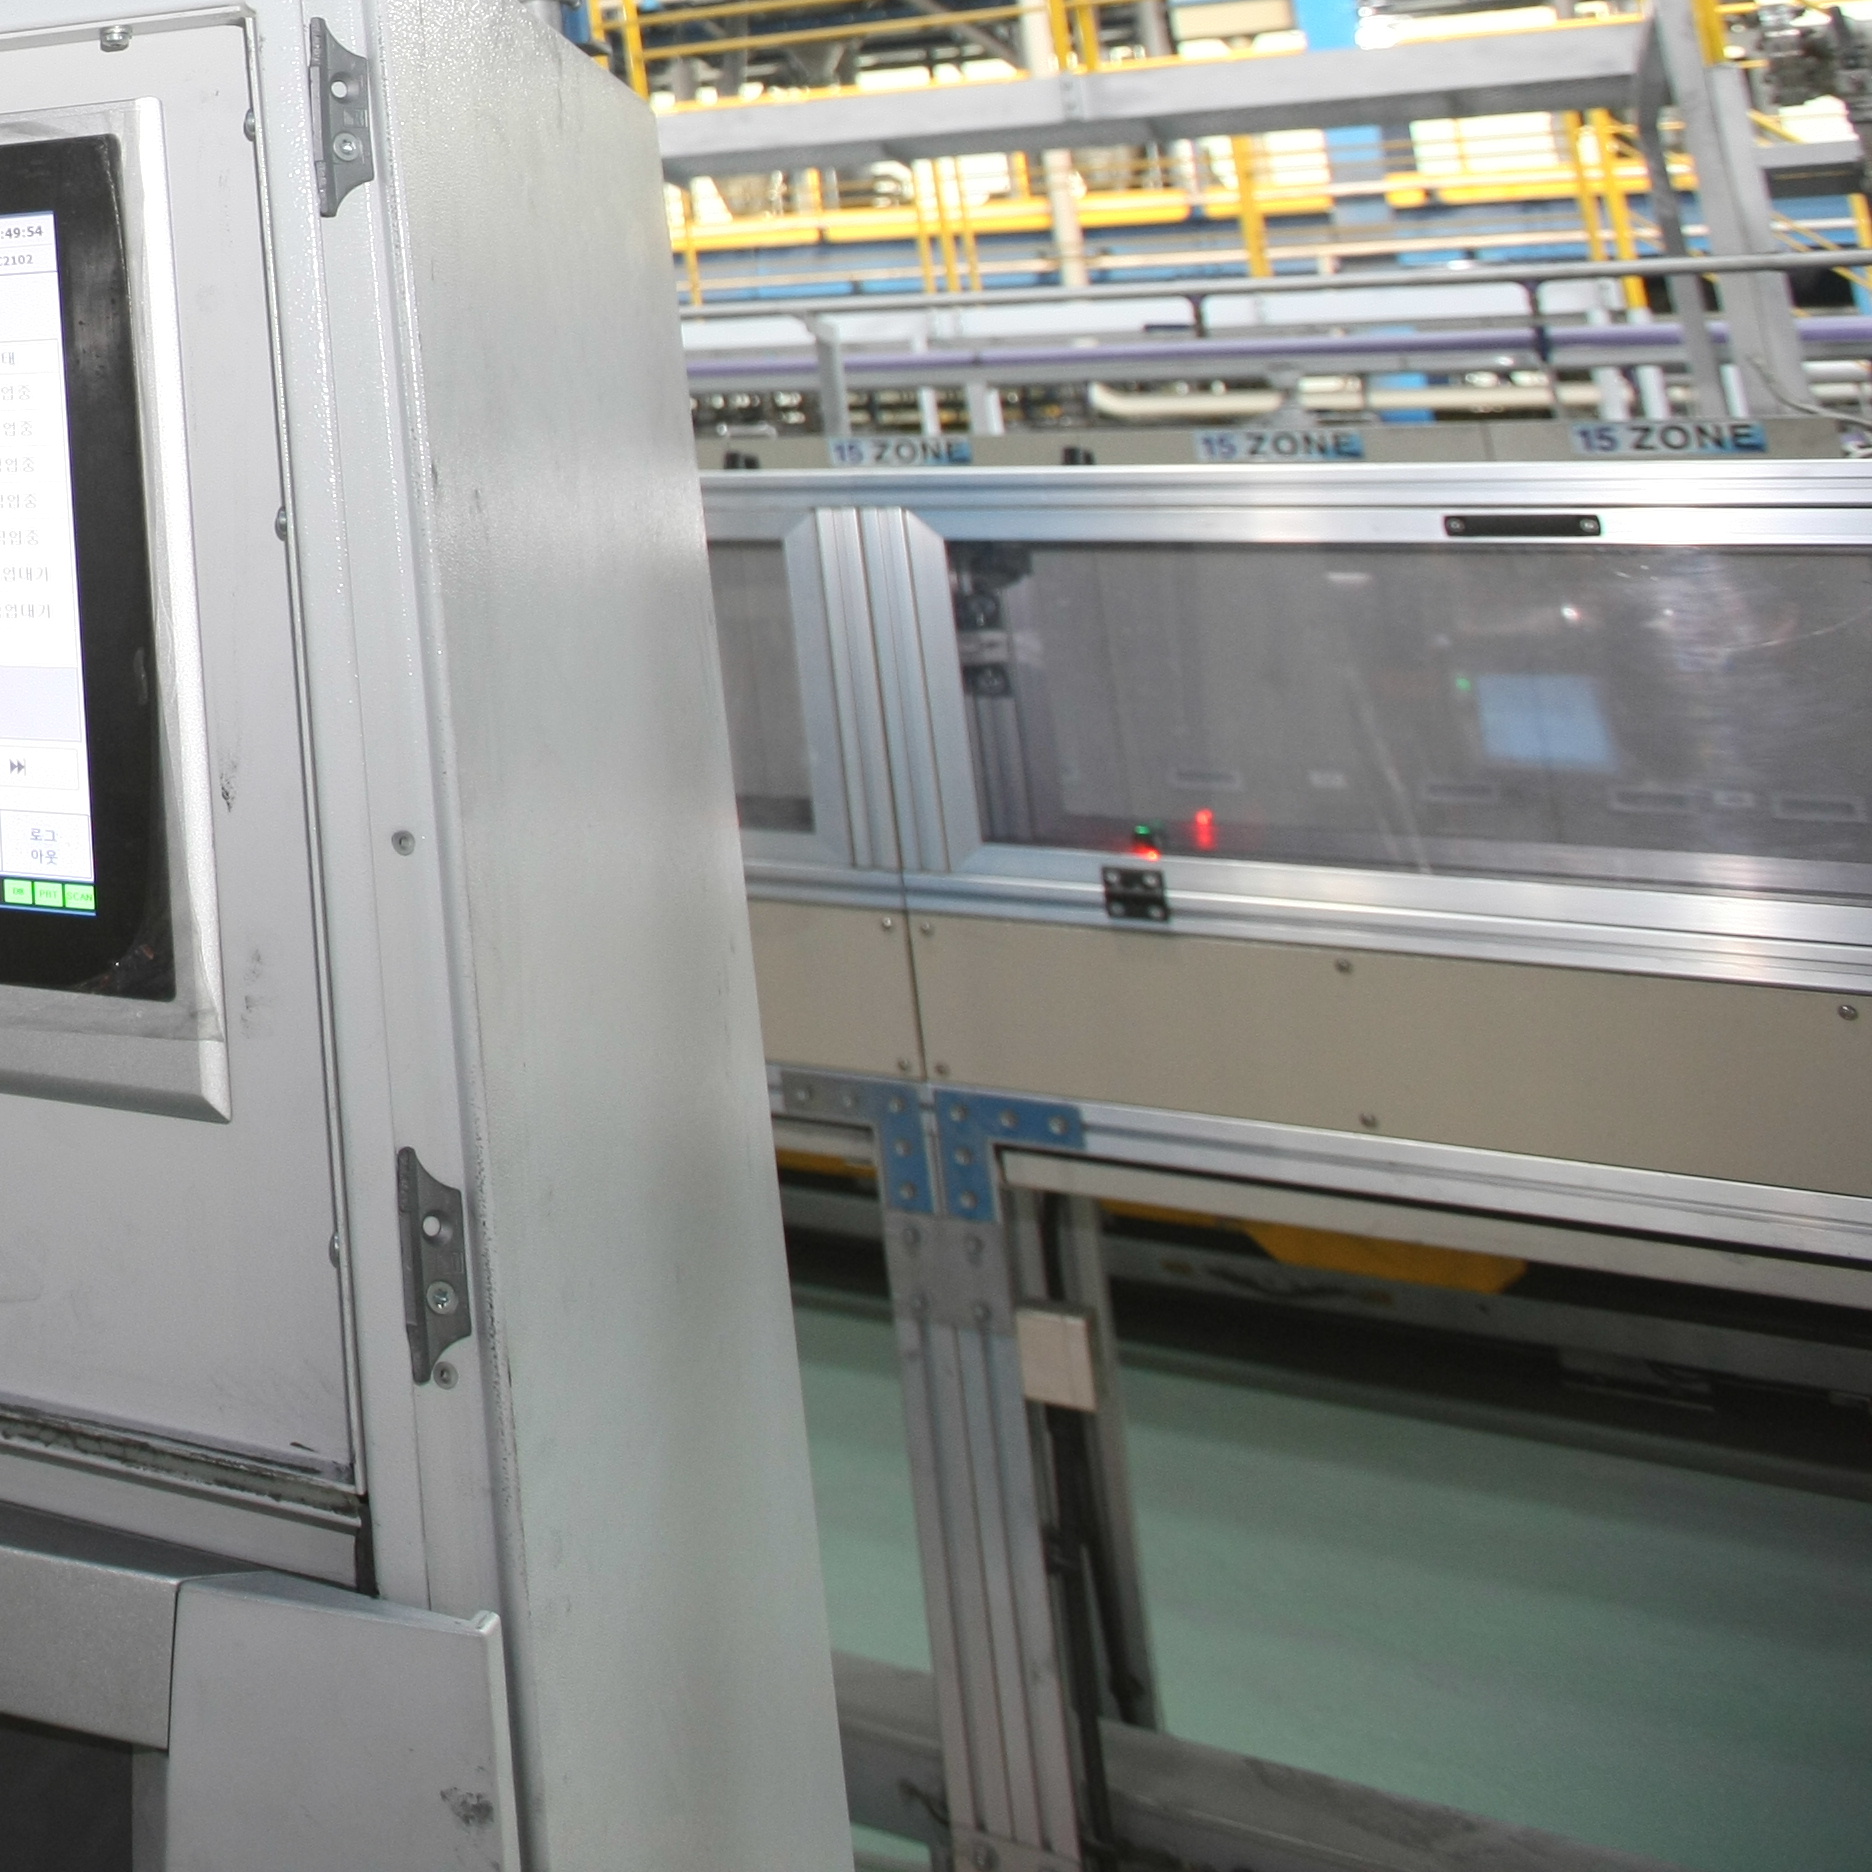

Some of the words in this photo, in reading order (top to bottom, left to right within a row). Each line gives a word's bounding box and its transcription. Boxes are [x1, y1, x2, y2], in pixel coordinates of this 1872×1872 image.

[1201, 434, 1236, 460] 15
[1245, 432, 1363, 458] ZONE
[1577, 427, 1618, 453] 15
[1629, 424, 1765, 453] ZONE
[832, 440, 865, 463] 15
[871, 440, 969, 463] ZONE
[29, 827, 58, 842] 로그
[30, 849, 59, 865] 아웃
[66, 892, 93, 902] SCAN
